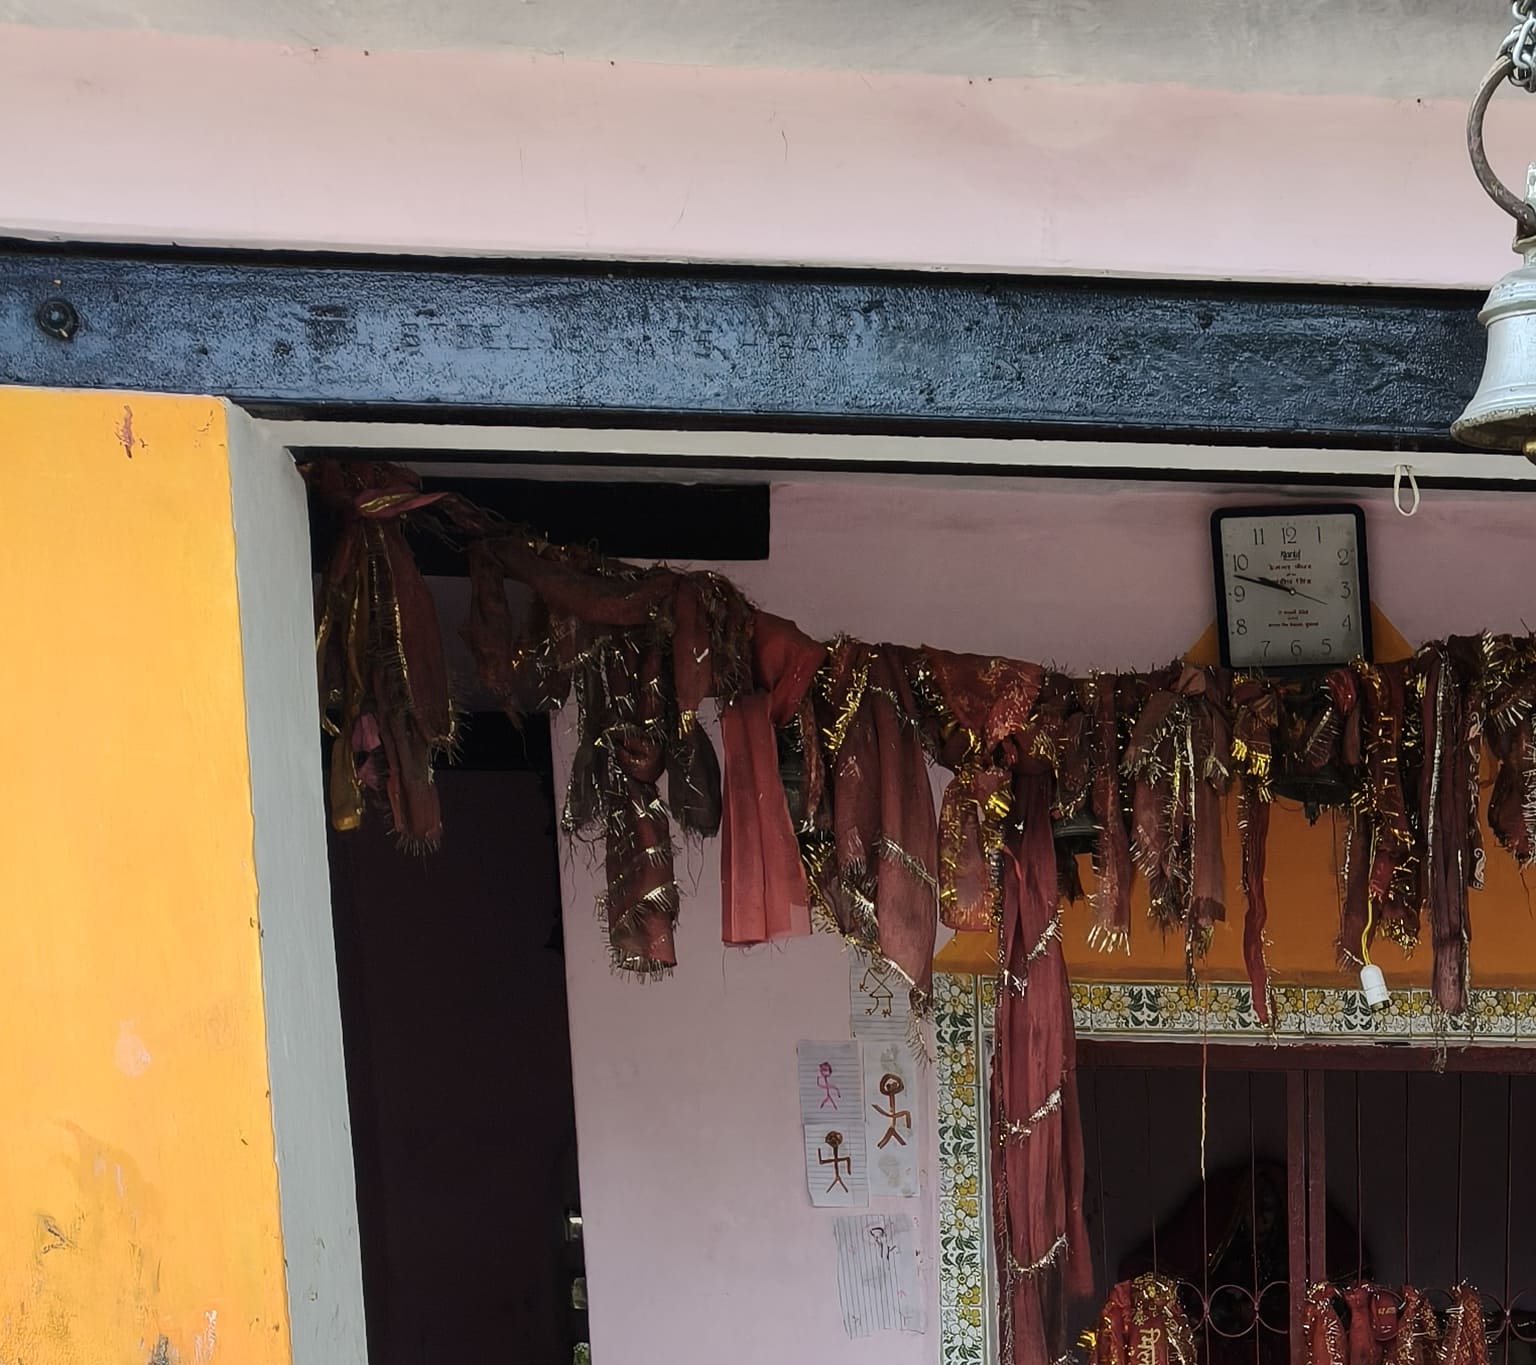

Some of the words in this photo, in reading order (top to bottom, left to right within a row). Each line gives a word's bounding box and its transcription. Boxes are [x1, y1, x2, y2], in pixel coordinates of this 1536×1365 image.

[1254, 527, 1265, 545] 11
[1281, 526, 1297, 545] 12
[1317, 526, 1322, 544] 1
[1233, 553, 1249, 572] 10
[1337, 548, 1350, 566] 2
[1234, 585, 1246, 602] 9
[1340, 581, 1351, 600] 3
[1236, 618, 1248, 635] 8
[1341, 614, 1352, 631] 4
[1260, 640, 1271, 657] 7
[1290, 640, 1302, 657] 6
[1321, 638, 1332, 656] 5
